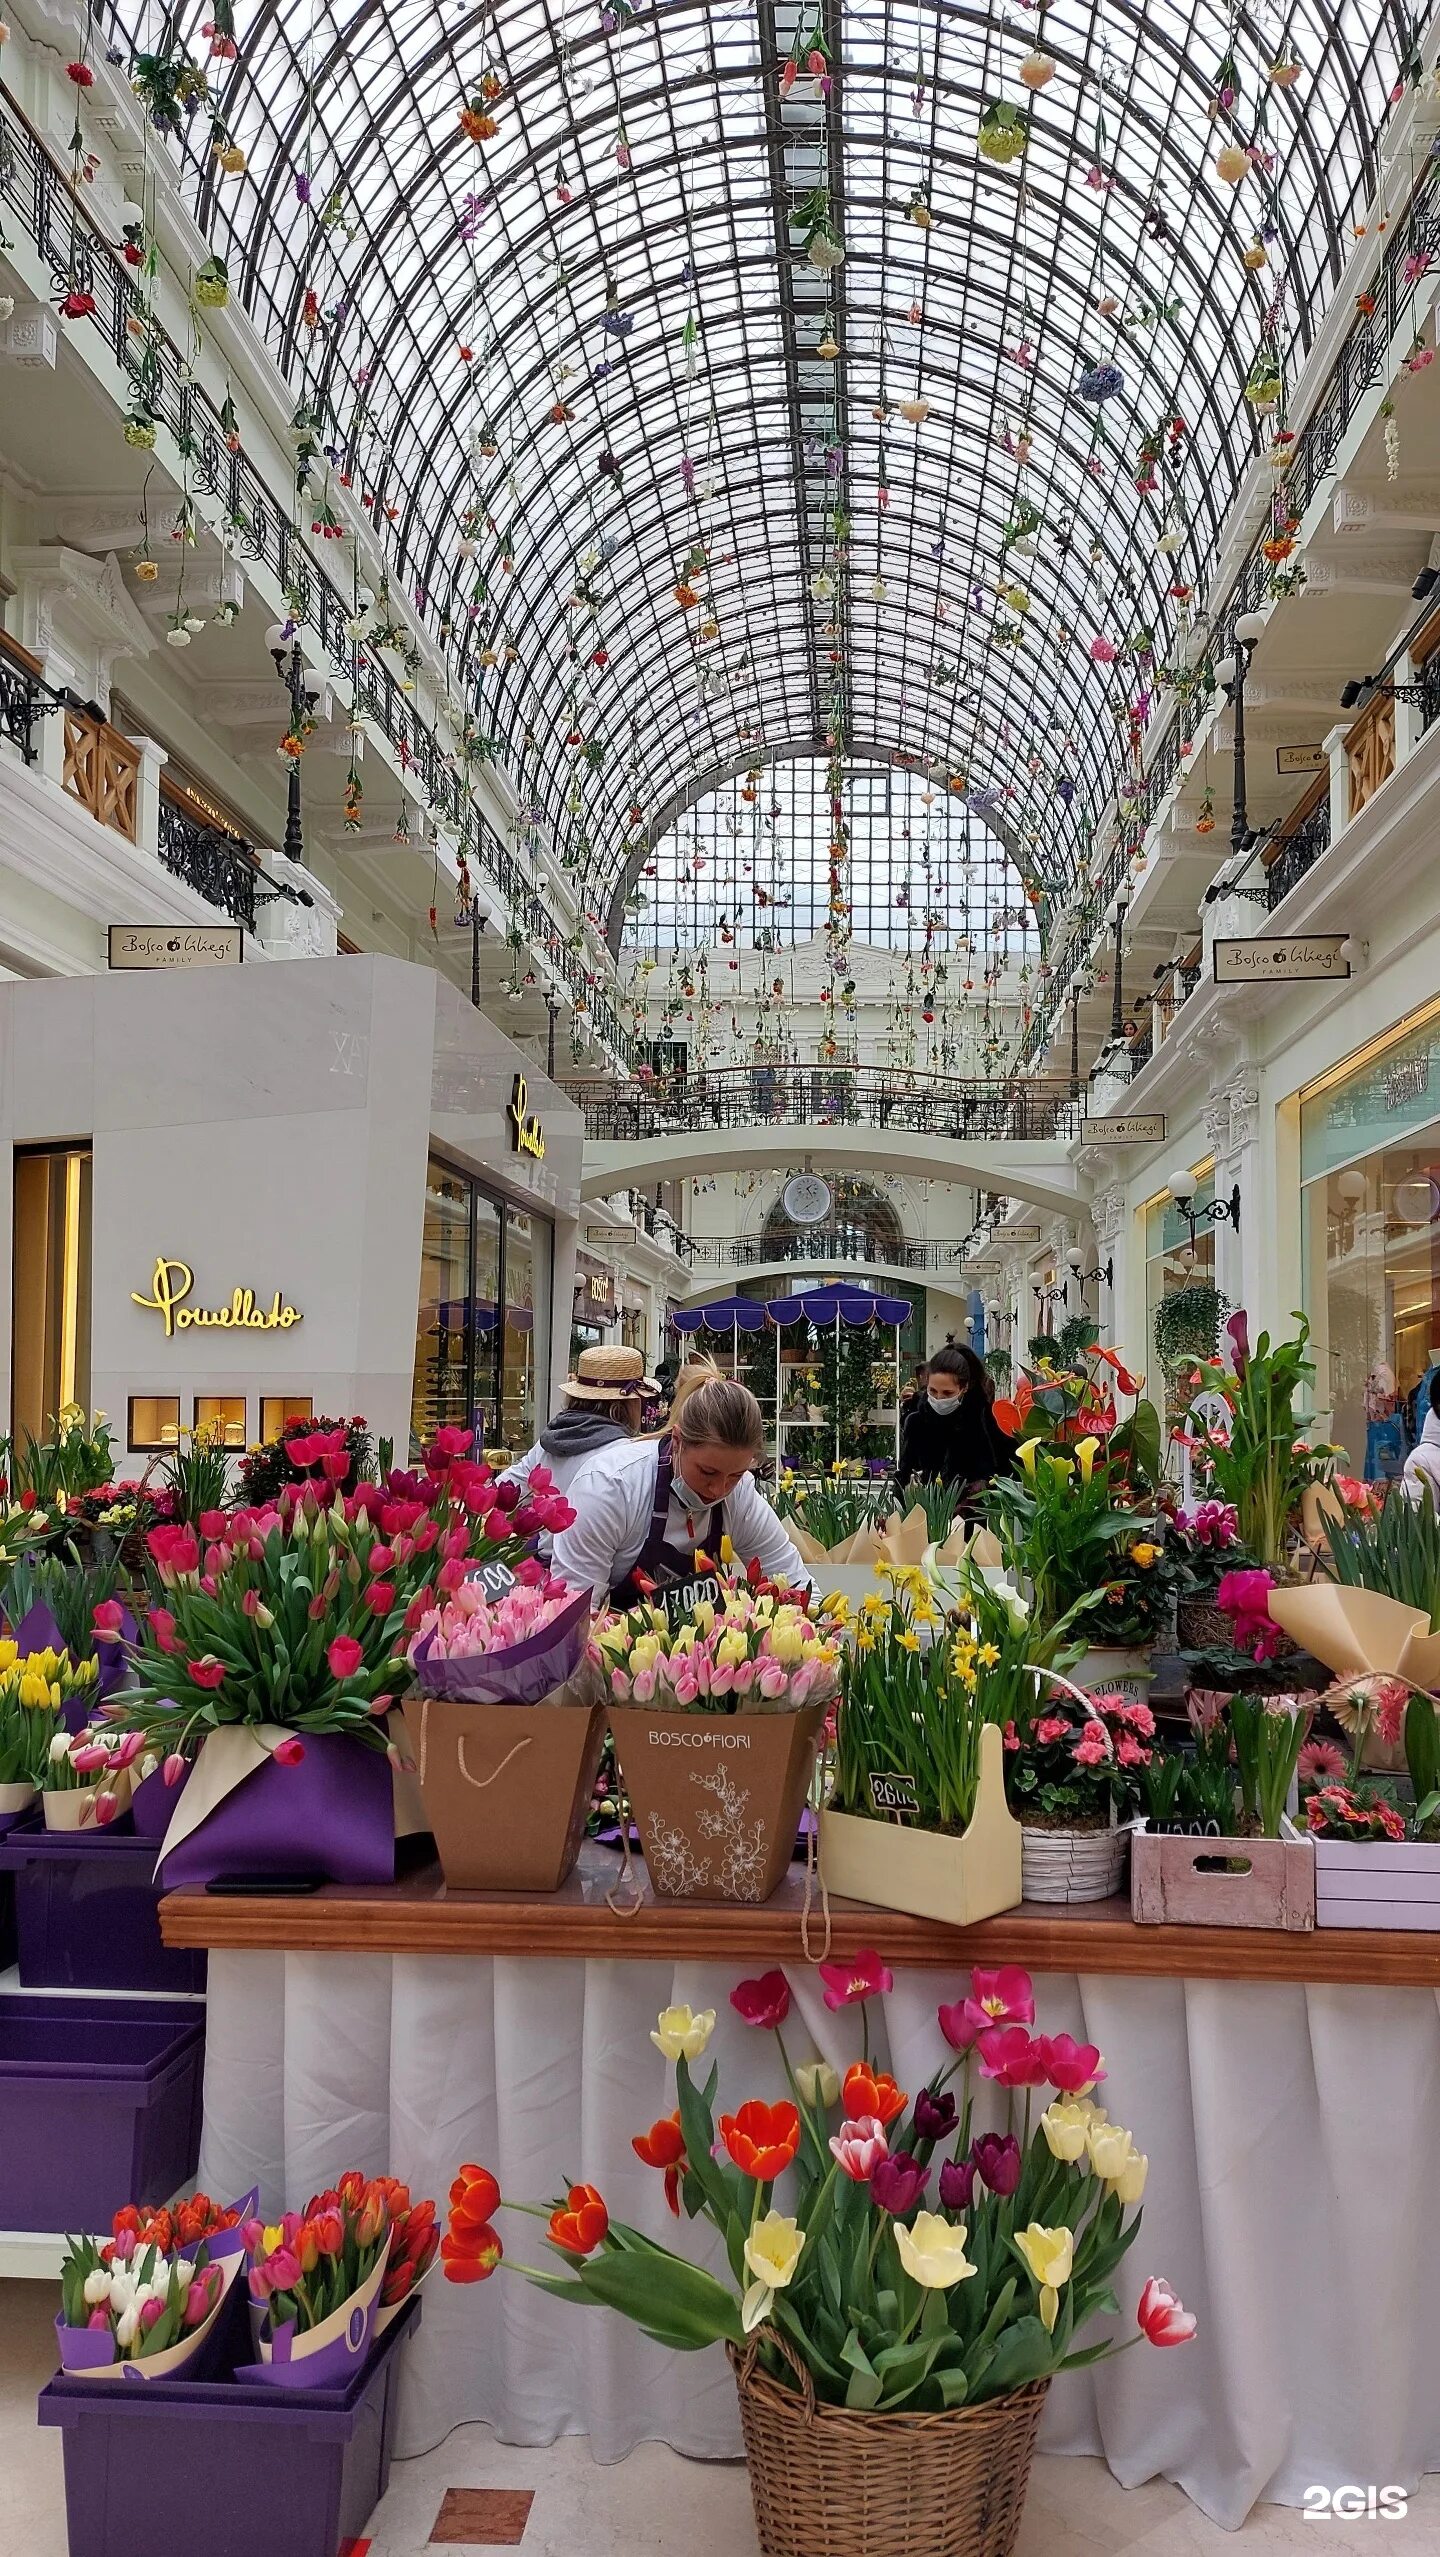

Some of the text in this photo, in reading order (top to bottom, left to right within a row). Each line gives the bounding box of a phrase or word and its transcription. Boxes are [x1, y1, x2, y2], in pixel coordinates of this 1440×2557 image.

[122, 935, 163, 956] Bosco
[1226, 949, 1269, 968] Bosco
[1088, 1123, 1115, 1136] Bosco
[1094, 1680, 1139, 1697] FLOWERS
[648, 1731, 751, 1749] BOSCO FIORI
